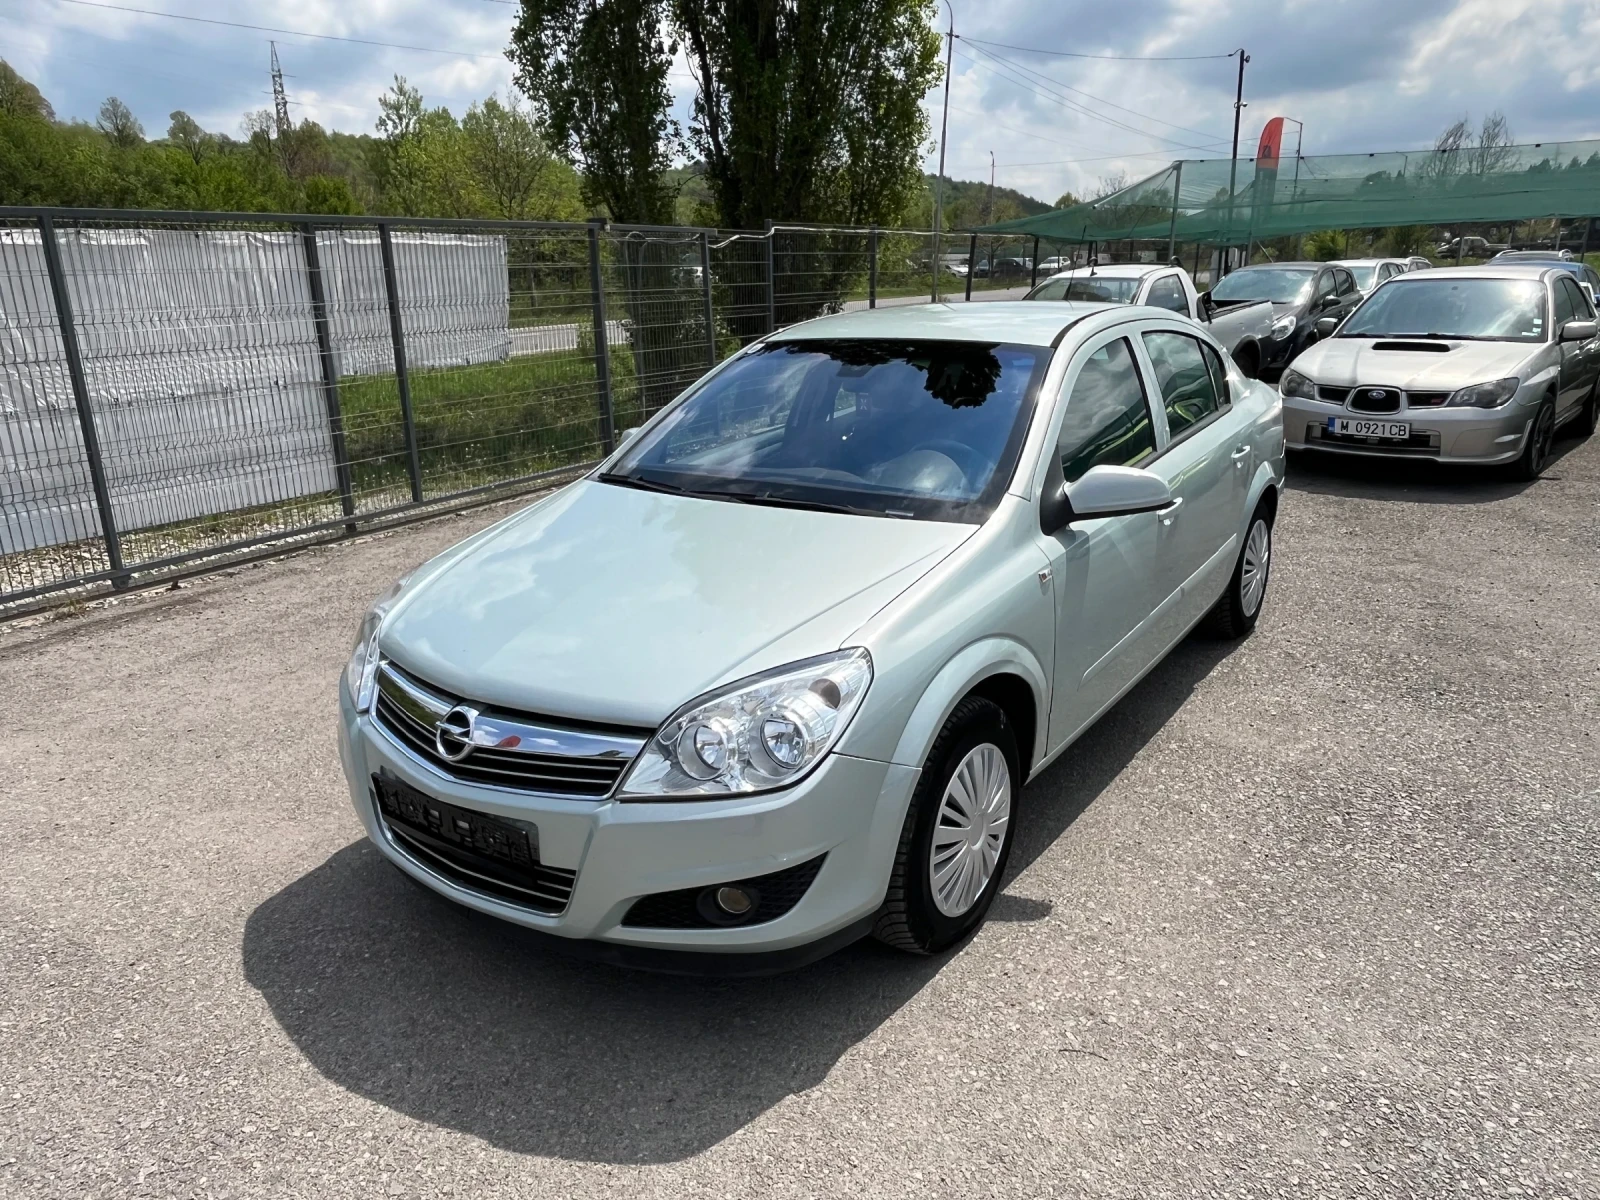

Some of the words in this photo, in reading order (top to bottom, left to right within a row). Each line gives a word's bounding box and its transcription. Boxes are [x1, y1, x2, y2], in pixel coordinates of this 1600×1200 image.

[1340, 420, 1349, 432] M
[1355, 422, 1386, 435] 0921
[1389, 424, 1407, 436] CB
